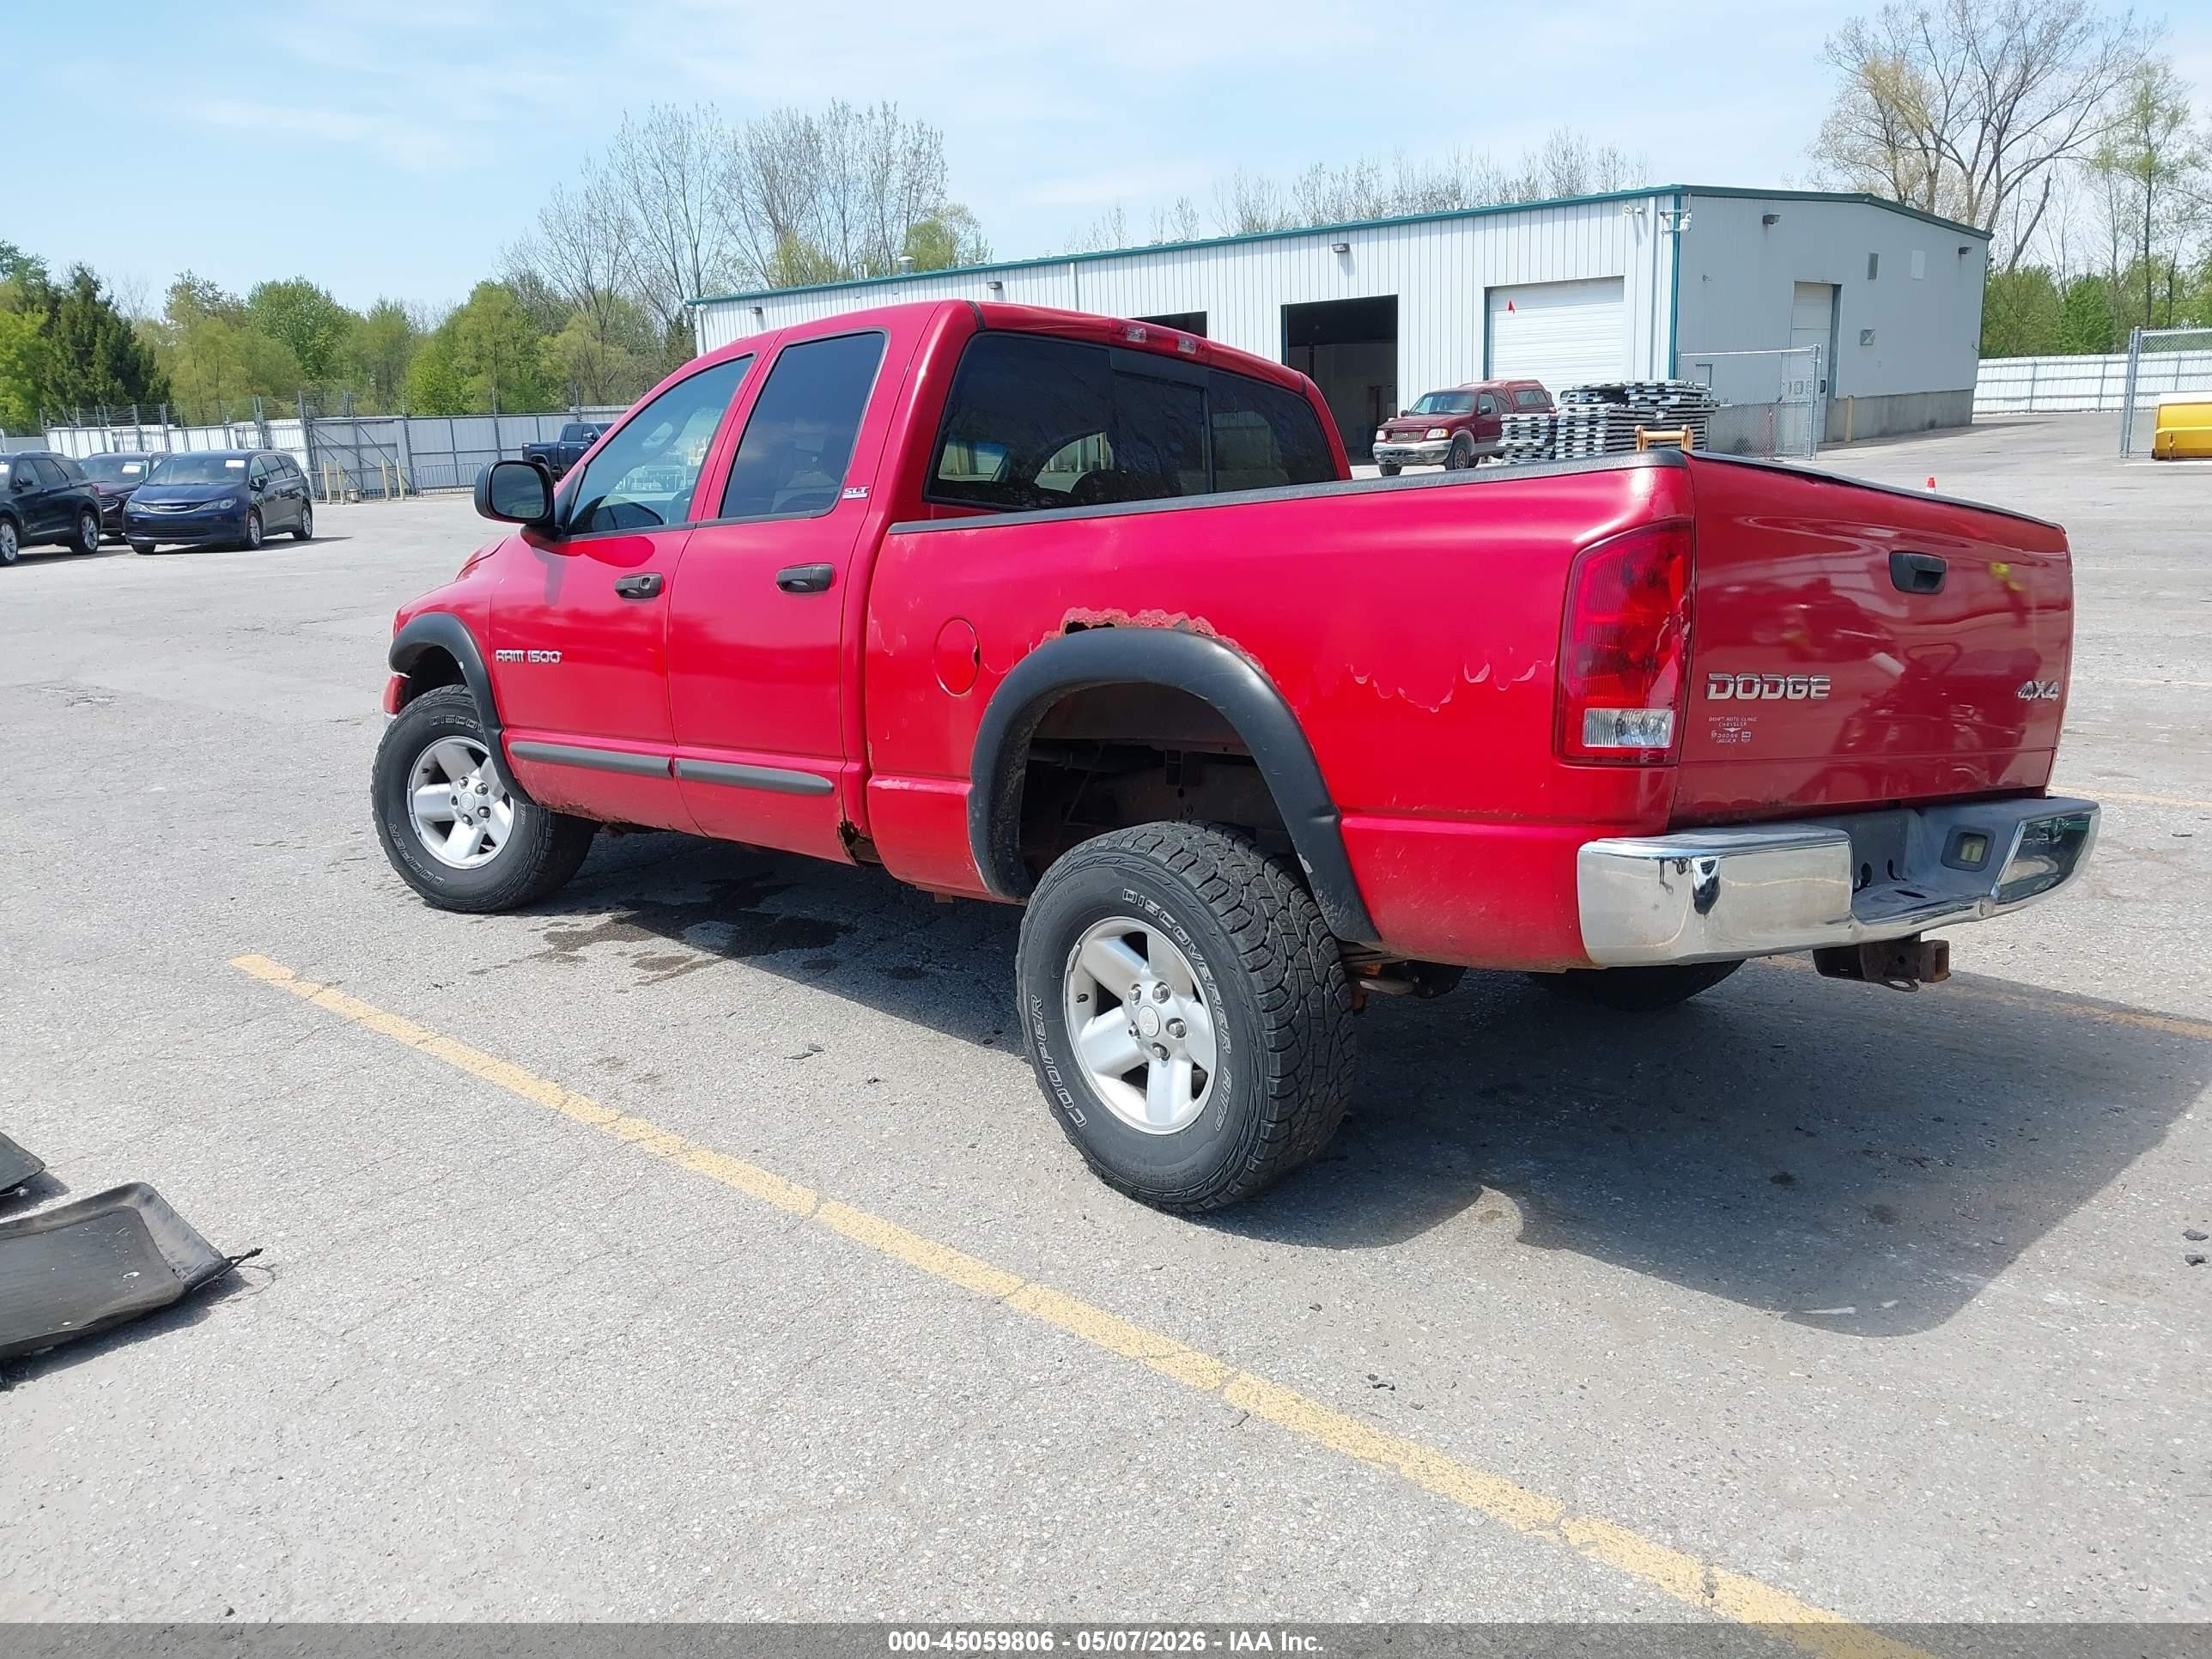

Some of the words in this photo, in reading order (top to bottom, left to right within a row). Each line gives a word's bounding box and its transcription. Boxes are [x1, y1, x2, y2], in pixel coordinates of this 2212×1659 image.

[844, 486, 869, 495] SLT
[495, 648, 525, 663] RAM
[527, 649, 562, 664] 1500
[1706, 672, 1831, 700] DODGE
[388, 823, 446, 887] COOPER
[1121, 888, 1233, 1055] DISCOVERER
[1030, 994, 1088, 1128] COOPER
